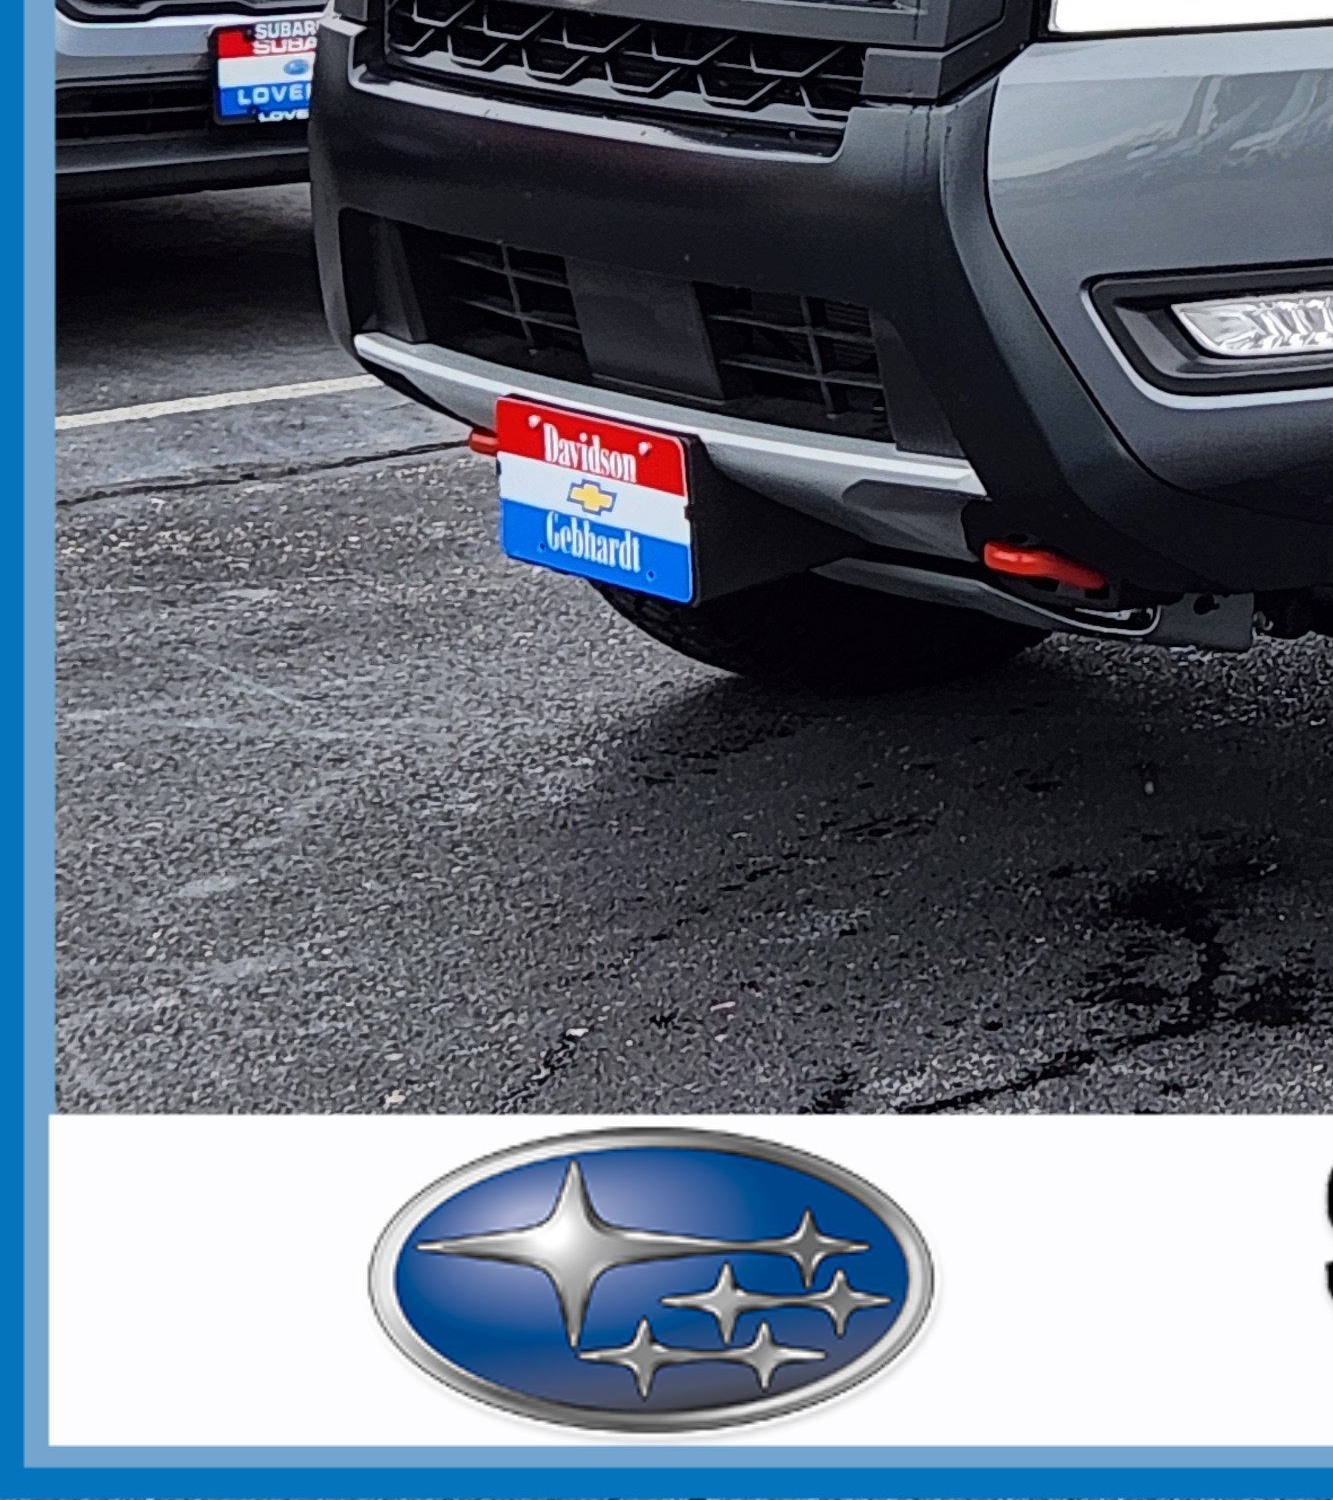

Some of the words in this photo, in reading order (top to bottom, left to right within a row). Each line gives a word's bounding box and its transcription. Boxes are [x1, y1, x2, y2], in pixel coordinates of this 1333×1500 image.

[255, 20, 319, 40] SUBAR
[542, 422, 637, 484] Davidson
[545, 510, 641, 574] Gebhardt
